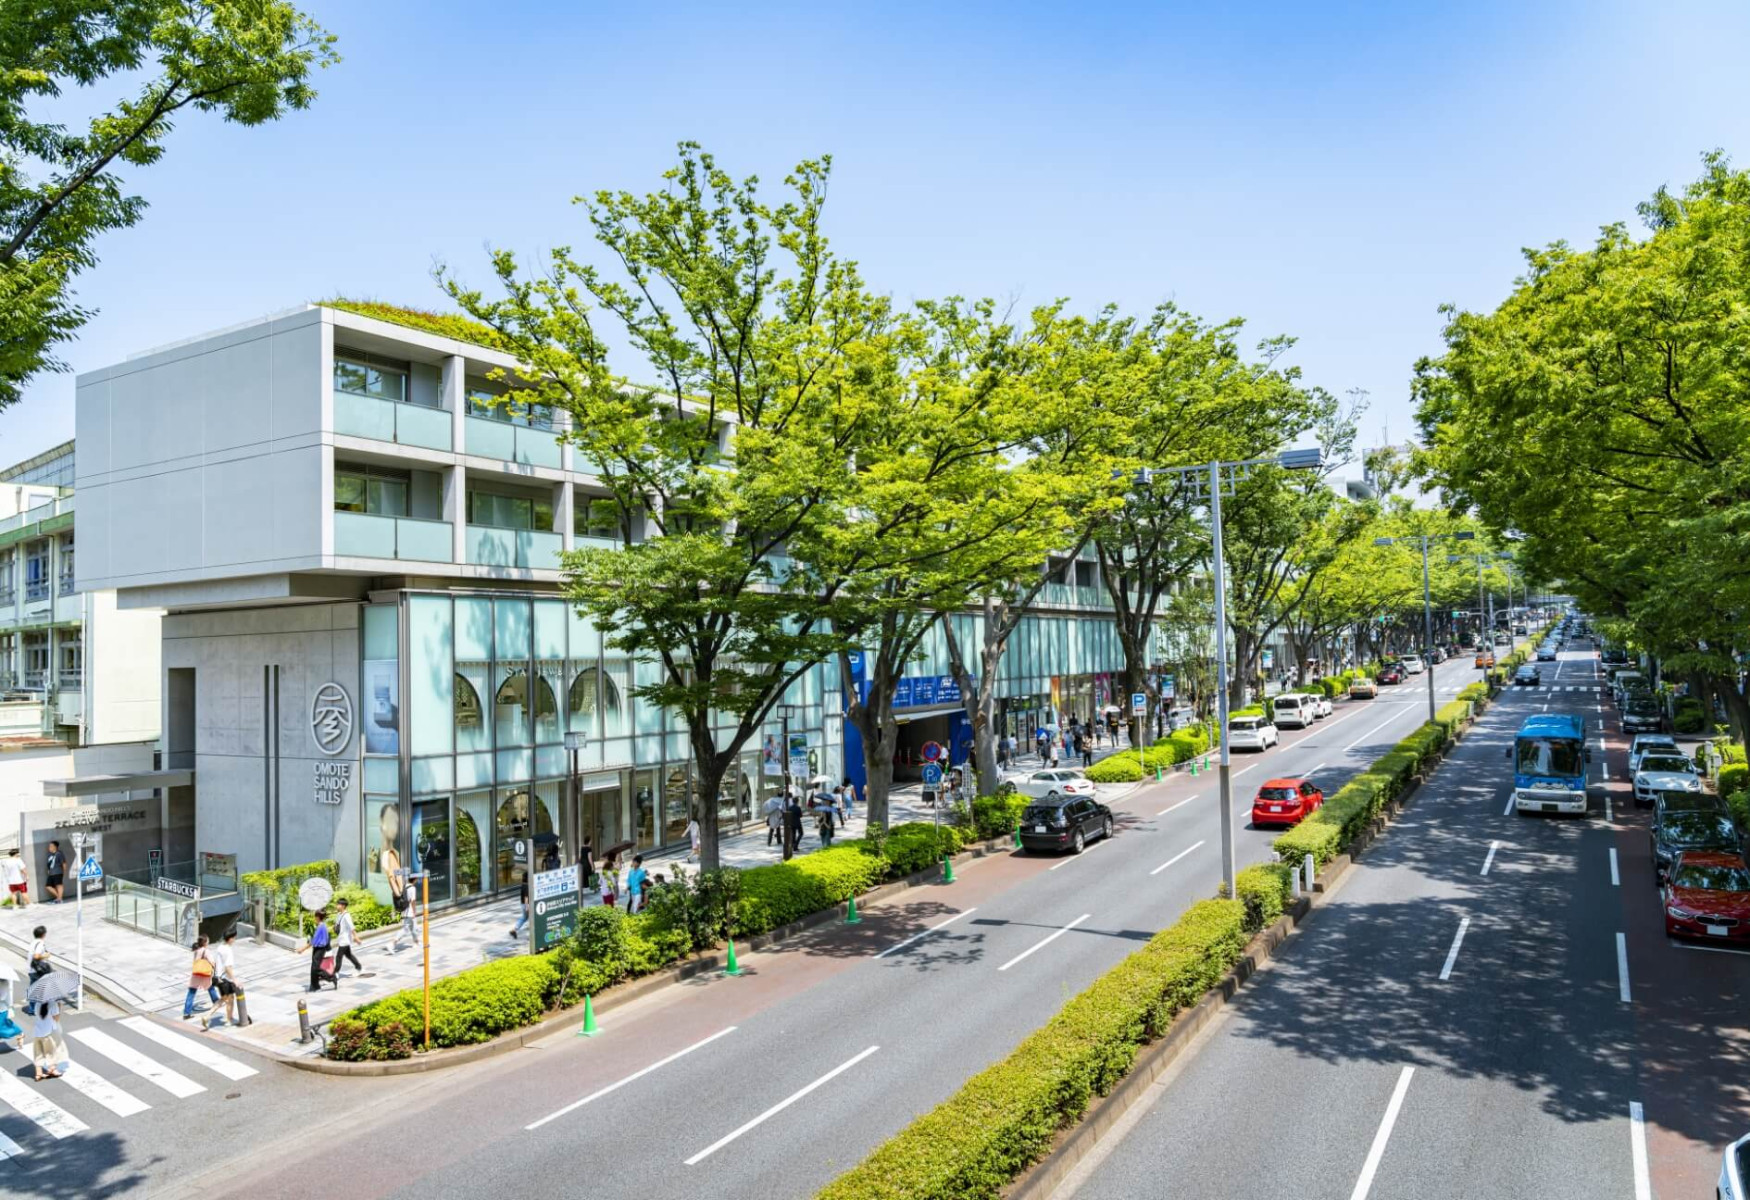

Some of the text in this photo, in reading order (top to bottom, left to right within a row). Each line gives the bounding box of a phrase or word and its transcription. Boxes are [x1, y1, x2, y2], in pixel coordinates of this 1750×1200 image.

[1133, 695, 1145, 706] P
[313, 762, 349, 776] OMOTE
[313, 776, 349, 790] SANDO
[313, 790, 341, 804] HILLS
[102, 811, 146, 823] TERRACE
[91, 823, 112, 832] WEST
[157, 880, 194, 898] STARBUCKS
